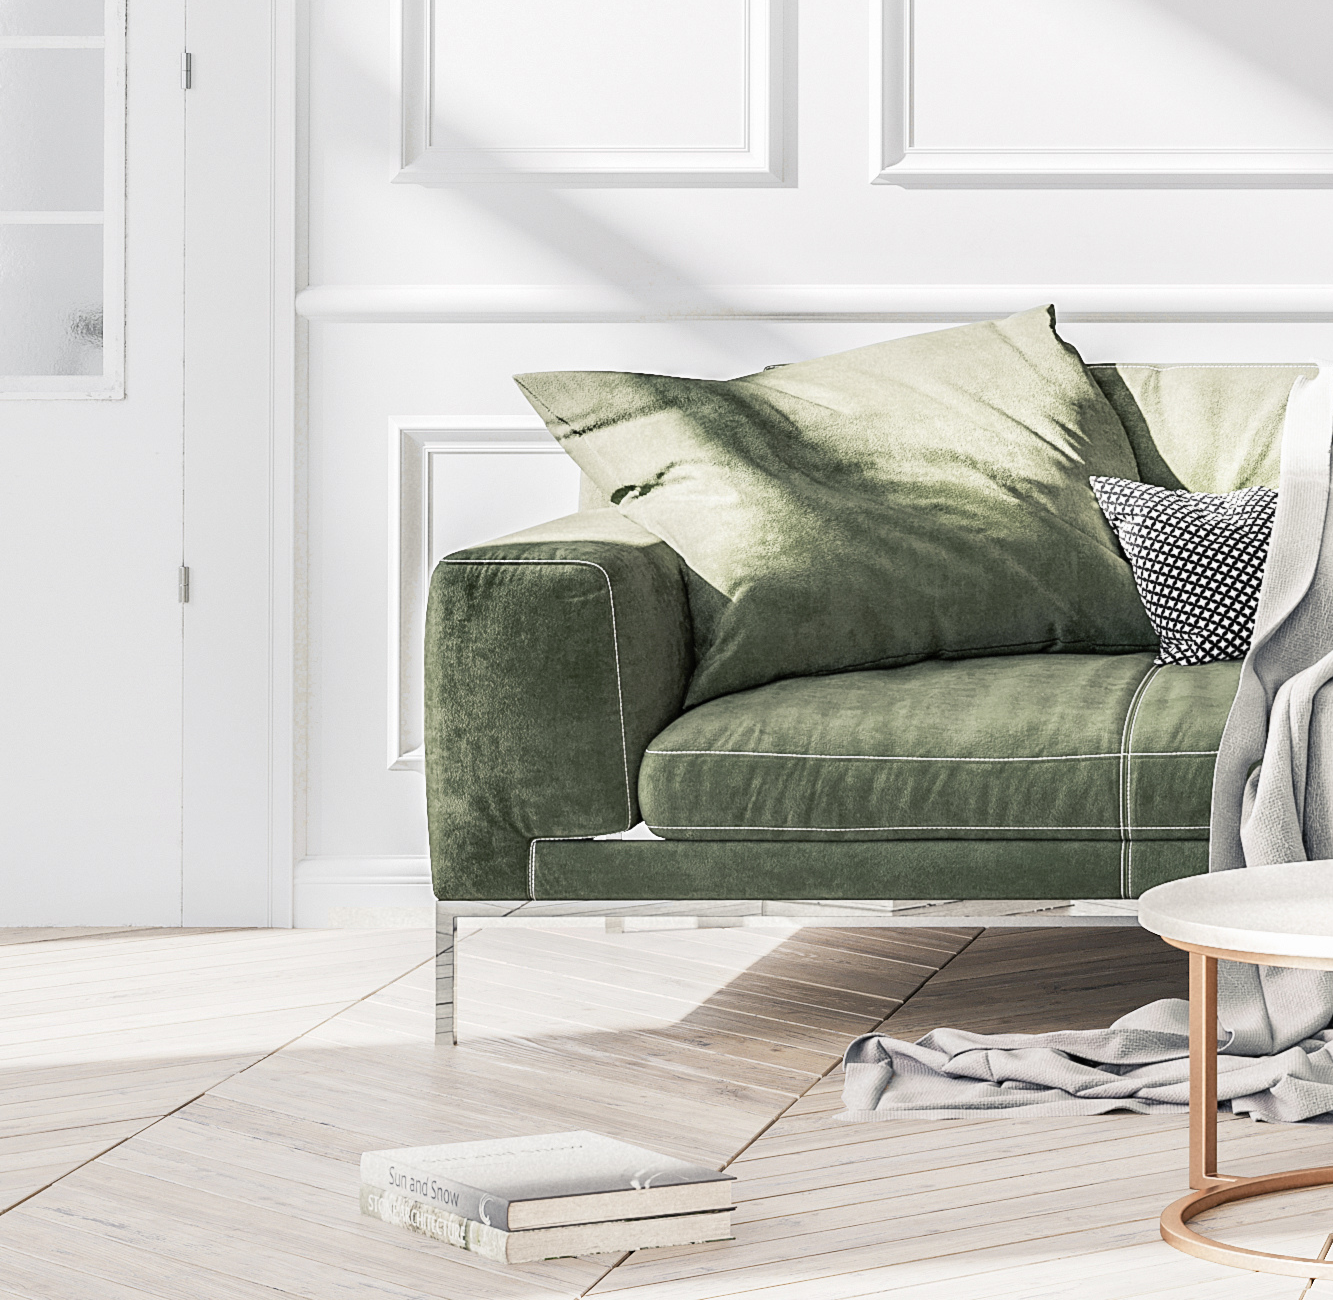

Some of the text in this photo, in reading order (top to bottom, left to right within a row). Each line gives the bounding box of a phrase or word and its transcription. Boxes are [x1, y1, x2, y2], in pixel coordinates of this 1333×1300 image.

[388, 1166, 460, 1207] Sun and Snow
[400, 1204, 466, 1244] ARCHITECTURE
